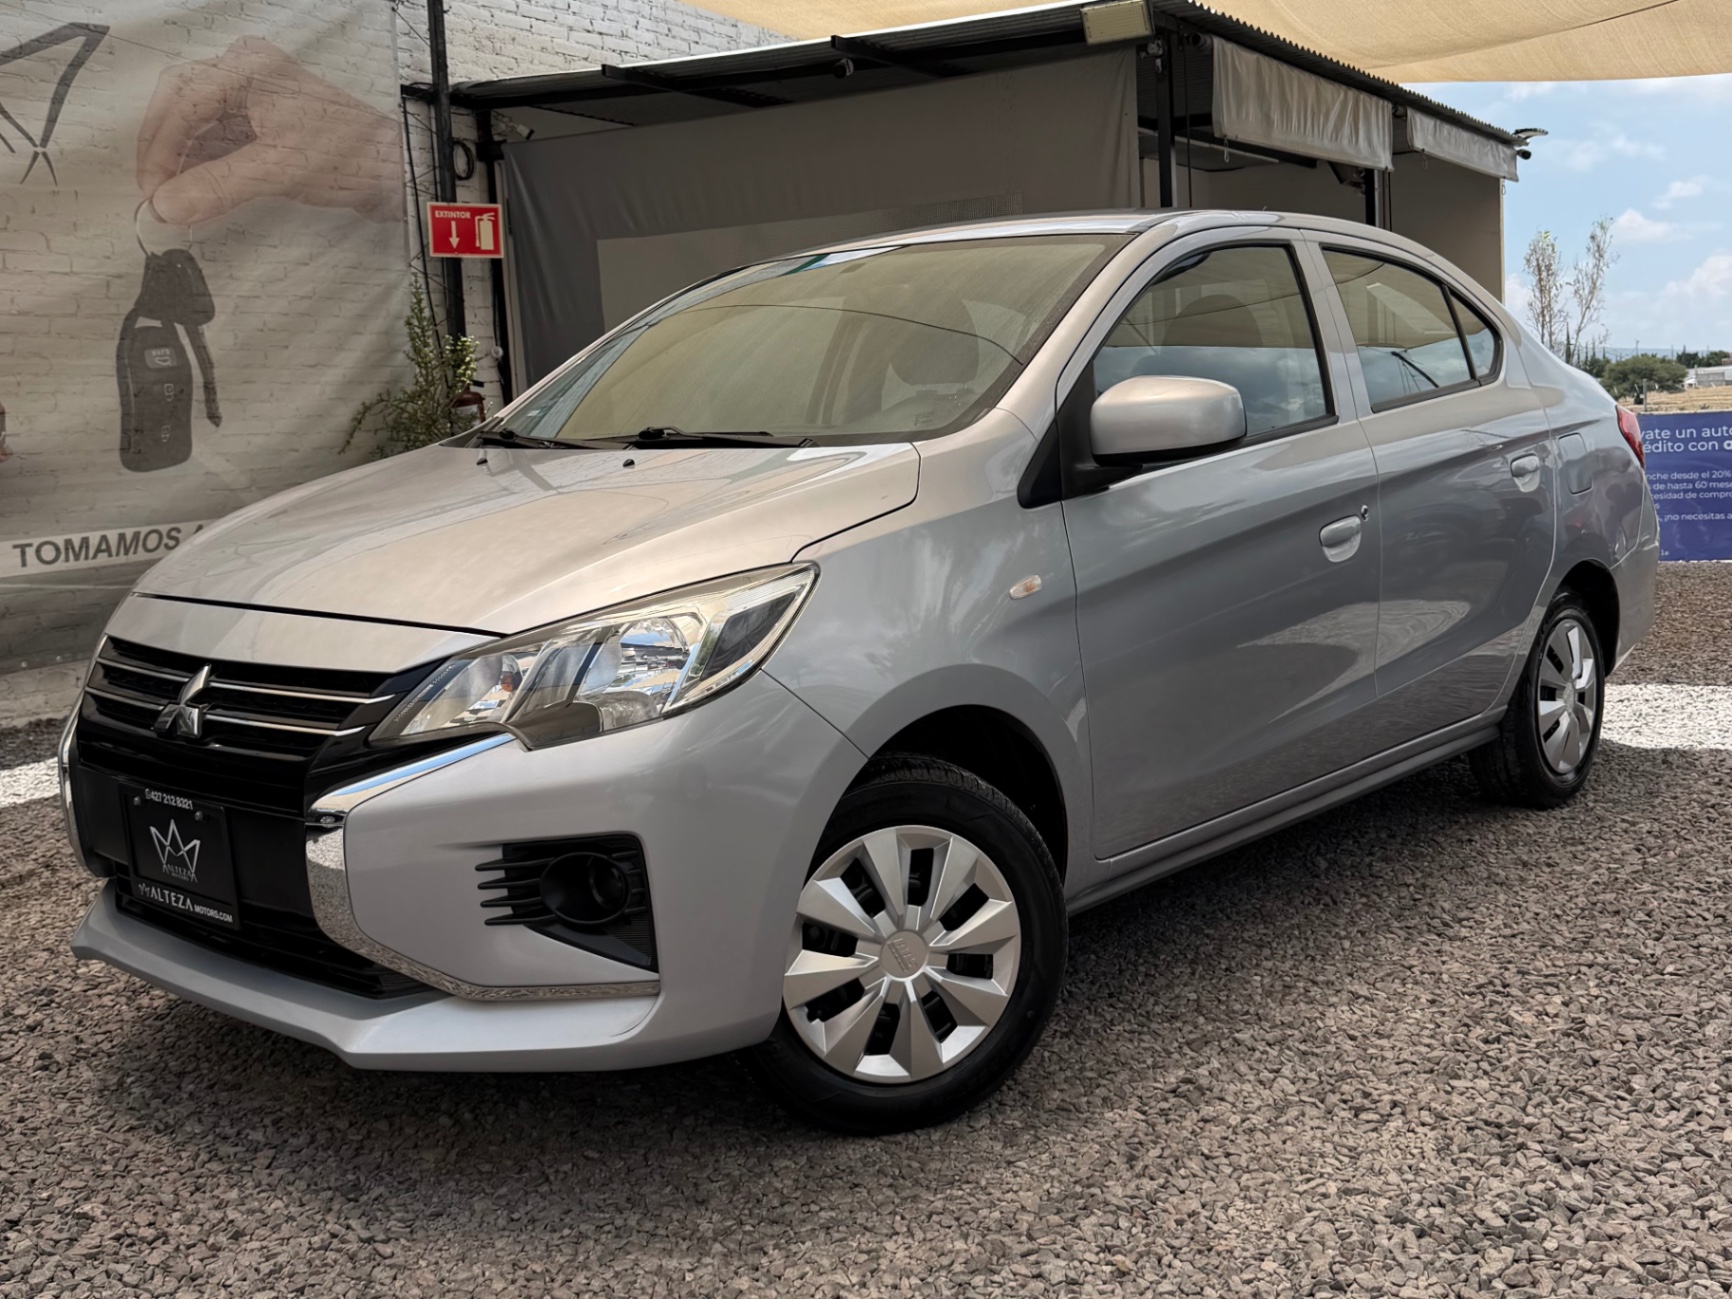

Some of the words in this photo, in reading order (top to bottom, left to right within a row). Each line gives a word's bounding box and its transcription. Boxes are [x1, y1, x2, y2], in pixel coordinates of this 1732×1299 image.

[434, 210, 471, 219] EXTINTOR
[1675, 428, 1697, 439] un
[1688, 440, 1719, 452] con
[1670, 471, 1699, 480] desde
[1701, 471, 1710, 479] el
[1711, 470, 1731, 479] 20%
[1653, 482, 1666, 490] de
[1667, 482, 1693, 490] hasta
[1695, 481, 1708, 489] 60
[1685, 491, 1697, 499] de
[1681, 512, 1725, 521] necesitas
[12, 526, 182, 568] TOMAMOS
[163, 793, 176, 806] 212
[150, 886, 193, 912] ALTEZA
[194, 904, 233, 923] MOTORS.COM
